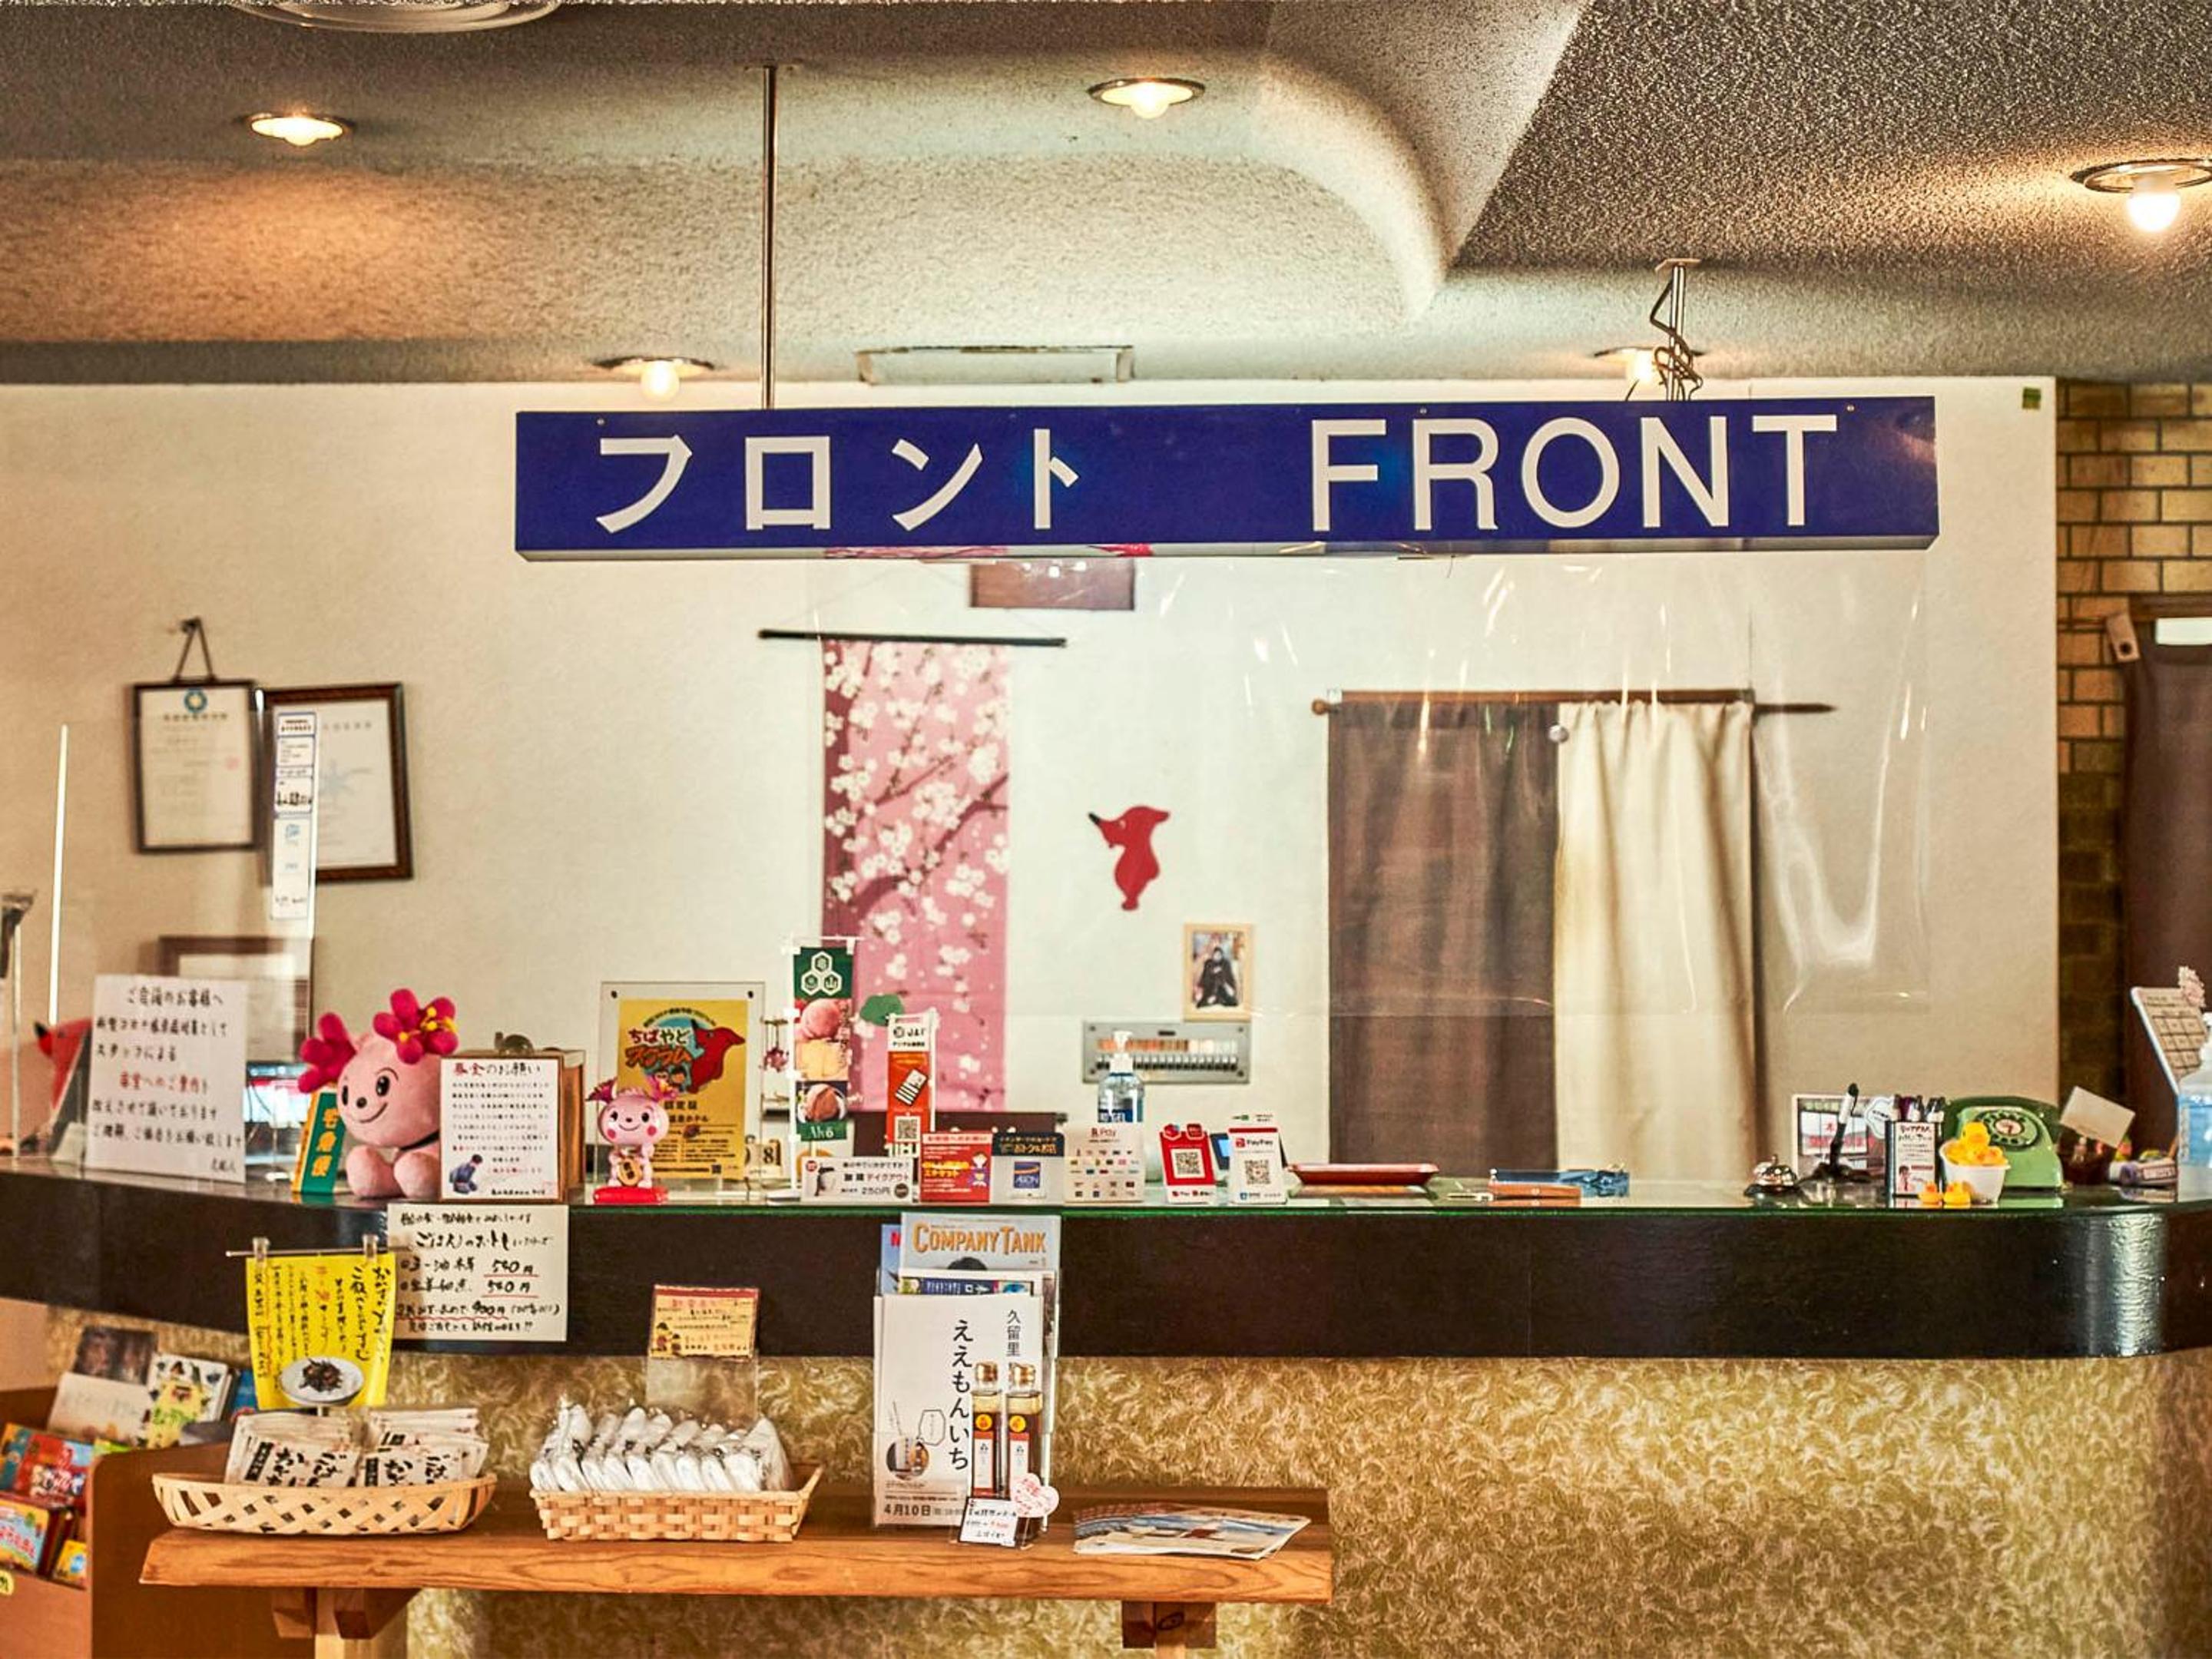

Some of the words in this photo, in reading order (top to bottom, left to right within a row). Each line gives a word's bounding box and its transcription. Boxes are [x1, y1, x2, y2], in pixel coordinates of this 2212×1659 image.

[595, 428, 1080, 533] フロント
[1310, 412, 1841, 531] FRONT
[912, 1222, 999, 1253] COMPANY
[1000, 1225, 1047, 1255] TANK
[1006, 1309, 1022, 1357] 久留里
[949, 1320, 974, 1470] ええもんいち
[884, 1503, 931, 1517] 4月10日
